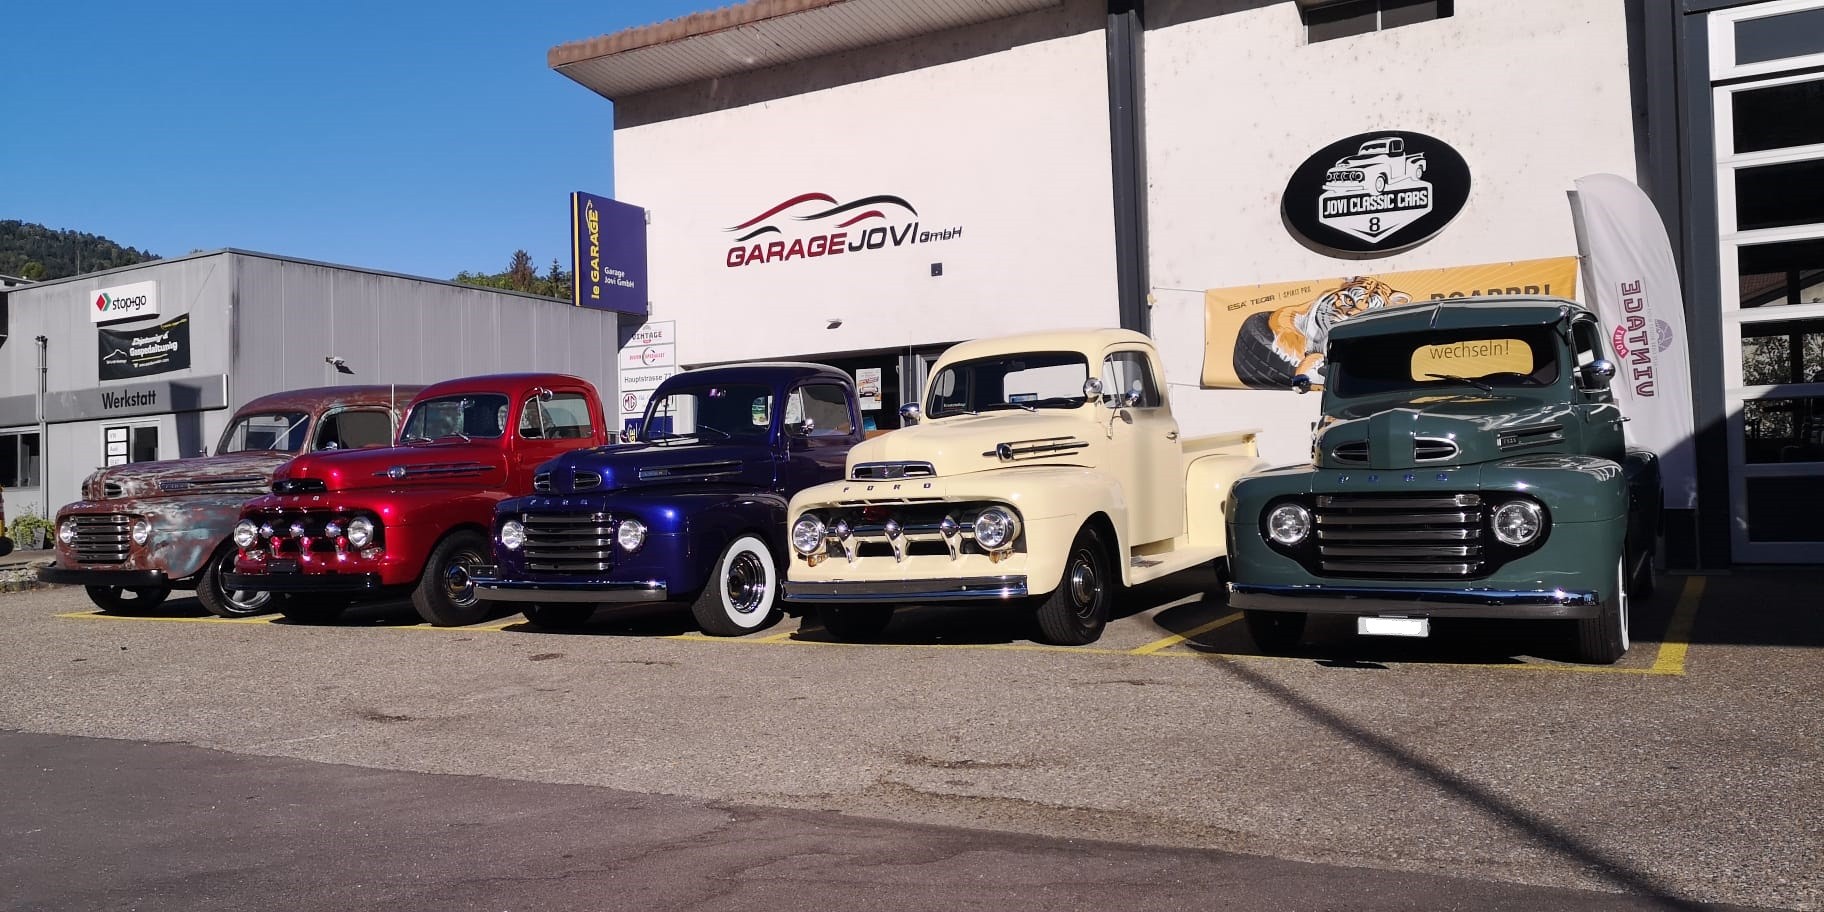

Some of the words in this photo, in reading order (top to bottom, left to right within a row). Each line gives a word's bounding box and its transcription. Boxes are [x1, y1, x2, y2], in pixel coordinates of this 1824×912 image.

[1324, 199, 1347, 215] JOVI
[1350, 194, 1395, 212] CLASSIC
[1397, 190, 1428, 208] CARS
[1369, 217, 1380, 232] 8
[589, 209, 600, 282] GARAGE
[726, 233, 848, 267] GARAGE
[848, 222, 919, 252] JOVI
[919, 226, 962, 243] GmbH
[604, 266, 625, 278] Garage
[604, 276, 616, 285] Jovi
[616, 278, 635, 288] GmbH
[591, 286, 600, 299] le
[1227, 302, 1246, 312] ESA
[1250, 294, 1275, 306] TECAR
[1283, 288, 1300, 298] SPIRIT
[1300, 286, 1311, 295] PRO
[112, 295, 147, 312] stop+go
[1430, 340, 1509, 360] wechseln!
[624, 375, 663, 384] Hauptstrasse
[101, 389, 157, 409] Werkstatt
[843, 482, 932, 493] FORD
